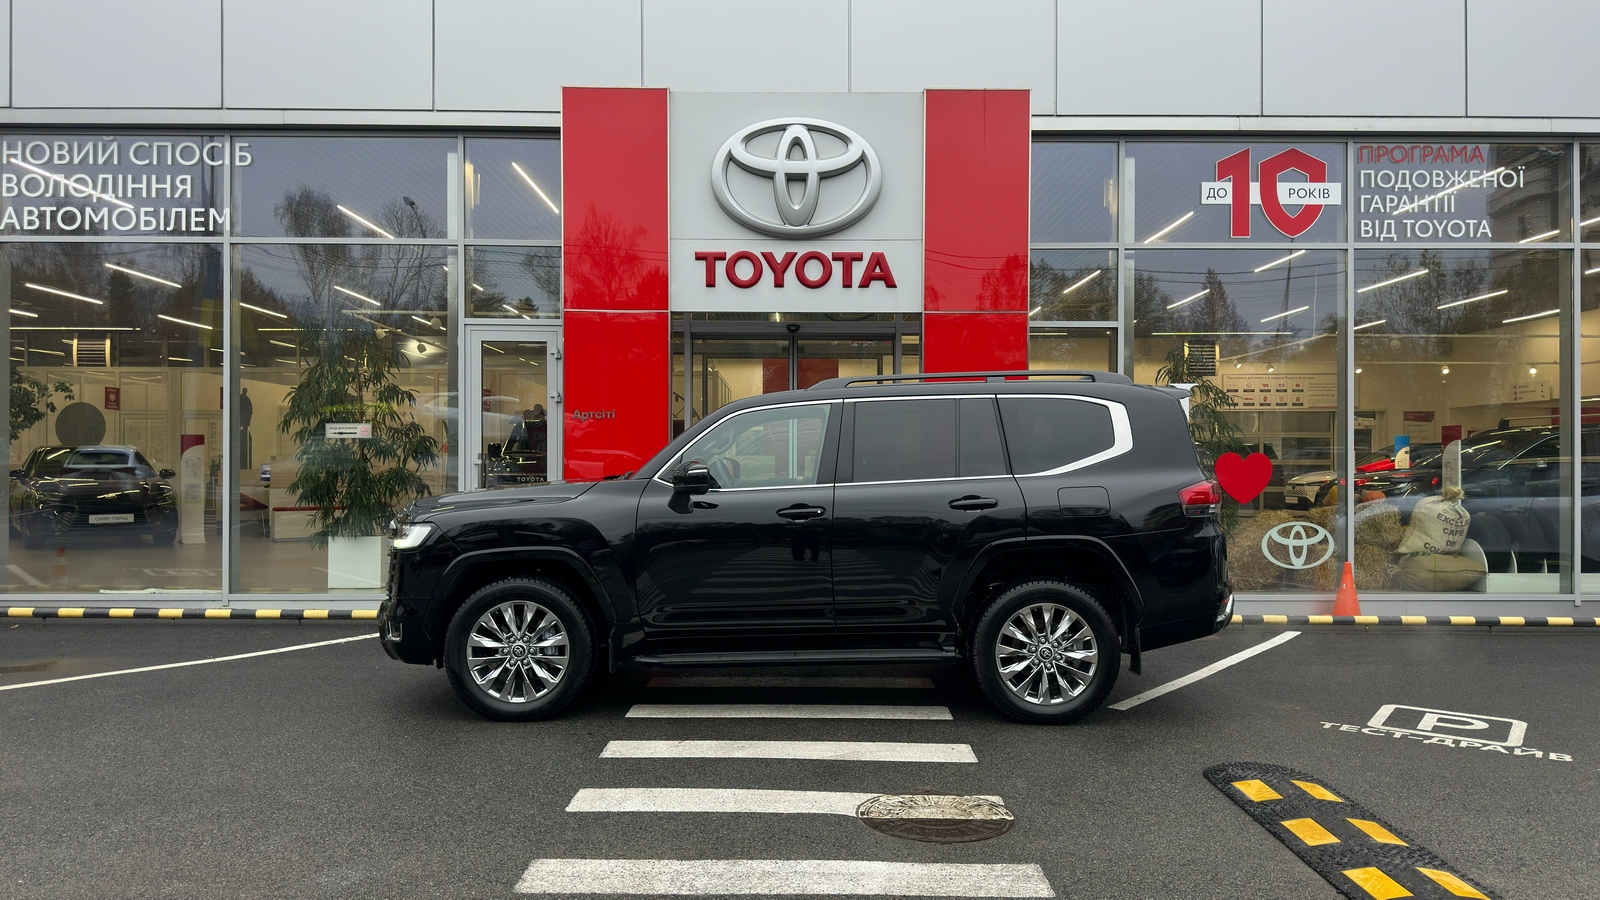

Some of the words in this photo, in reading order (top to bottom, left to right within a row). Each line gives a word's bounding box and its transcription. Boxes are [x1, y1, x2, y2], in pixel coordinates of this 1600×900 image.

[3, 136, 118, 165] НОВИЙ
[129, 142, 252, 166] СПОСІБ
[1359, 145, 1485, 163] ПРОГРАМА
[2, 173, 191, 202] ВОЛОДІННЯ
[1360, 165, 1526, 192] ПОДОВЖЕНОЇ
[1206, 187, 1228, 201] ДО
[1216, 147, 1327, 238] 10
[1288, 187, 1330, 199] РОКІВ
[1360, 191, 1458, 213] ГАРАНТІЇ
[0, 206, 230, 231] АВТОМОБІЛЕМ
[1360, 220, 1397, 242] ВІД
[1403, 220, 1492, 238] TOYOTA
[695, 250, 898, 289] TOYOTA
[573, 409, 616, 422] Артсіті
[1446, 540, 1457, 548] DE
[1320, 721, 1573, 762] ТЕСТ-ДРАЙВ
